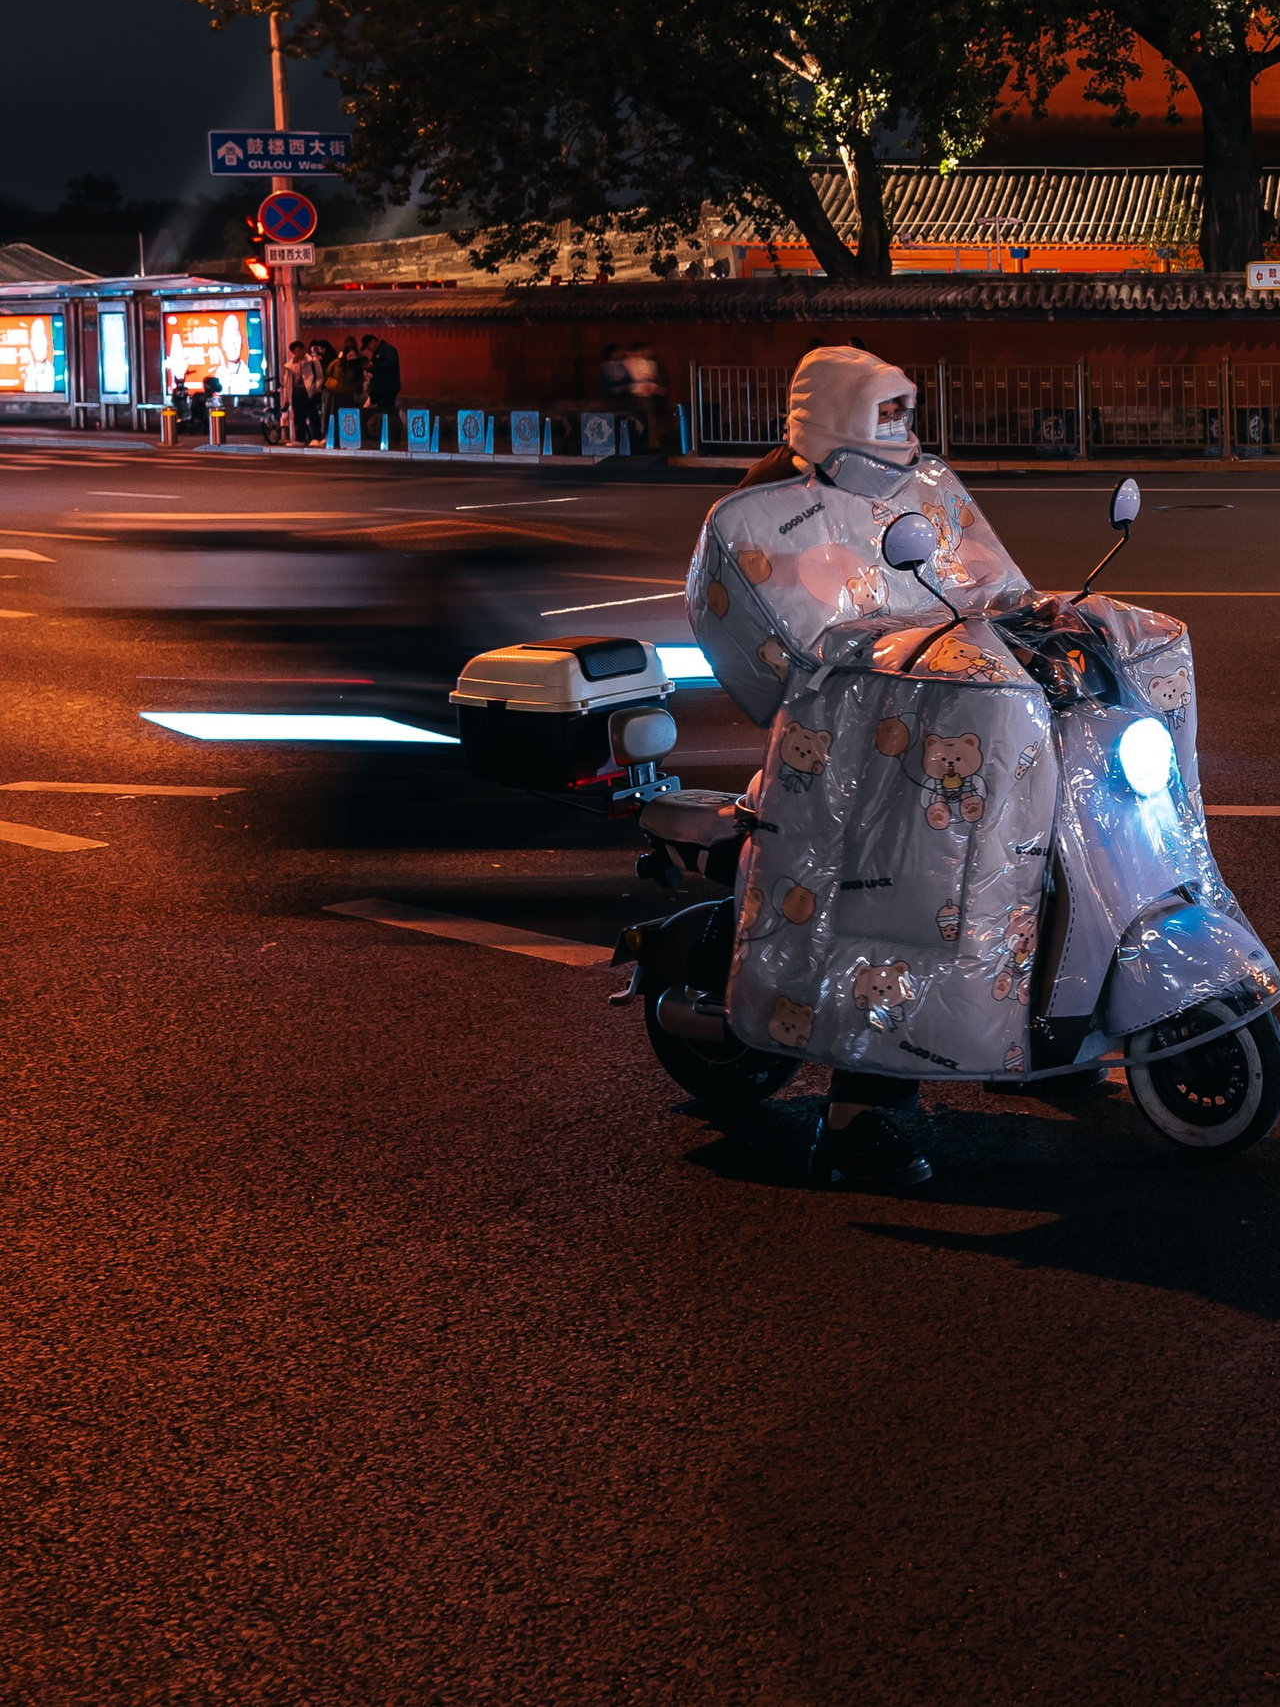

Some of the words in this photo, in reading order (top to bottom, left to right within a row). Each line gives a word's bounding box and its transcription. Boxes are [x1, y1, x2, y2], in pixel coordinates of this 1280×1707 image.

[247, 138, 345, 156] 鼓楼西大街
[248, 160, 292, 170] GULOU
[298, 161, 329, 170] Wes
[270, 248, 311, 261] 鼓楼西大街
[779, 515, 804, 534] GOOD
[802, 502, 825, 518] LUCK
[1016, 845, 1042, 856] GOD
[864, 878, 893, 889] LUCK
[899, 1041, 930, 1059] GOOD
[930, 1053, 960, 1071] LUCK
